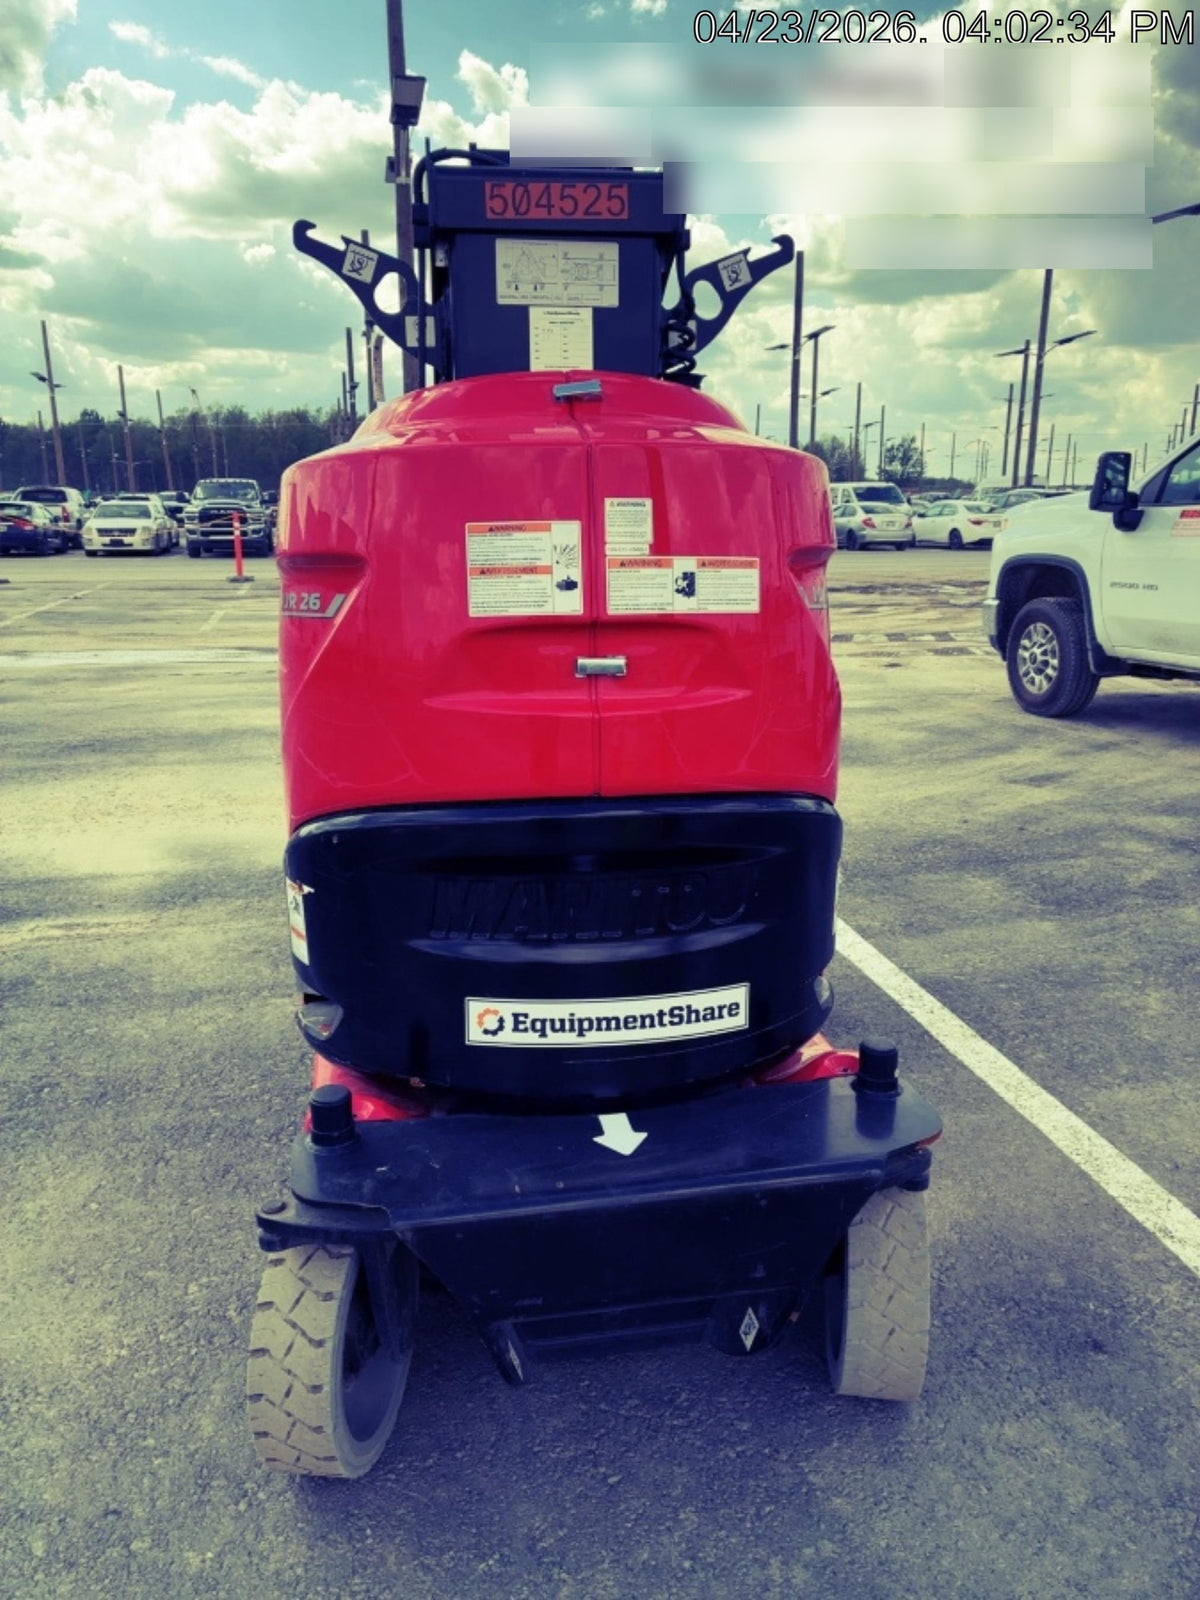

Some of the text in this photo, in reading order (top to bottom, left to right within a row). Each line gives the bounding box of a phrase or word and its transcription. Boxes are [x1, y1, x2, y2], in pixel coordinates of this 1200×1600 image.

[488, 182, 627, 217] 504525
[299, 592, 321, 610] 26
[511, 1000, 741, 1039] EquipmentShare
